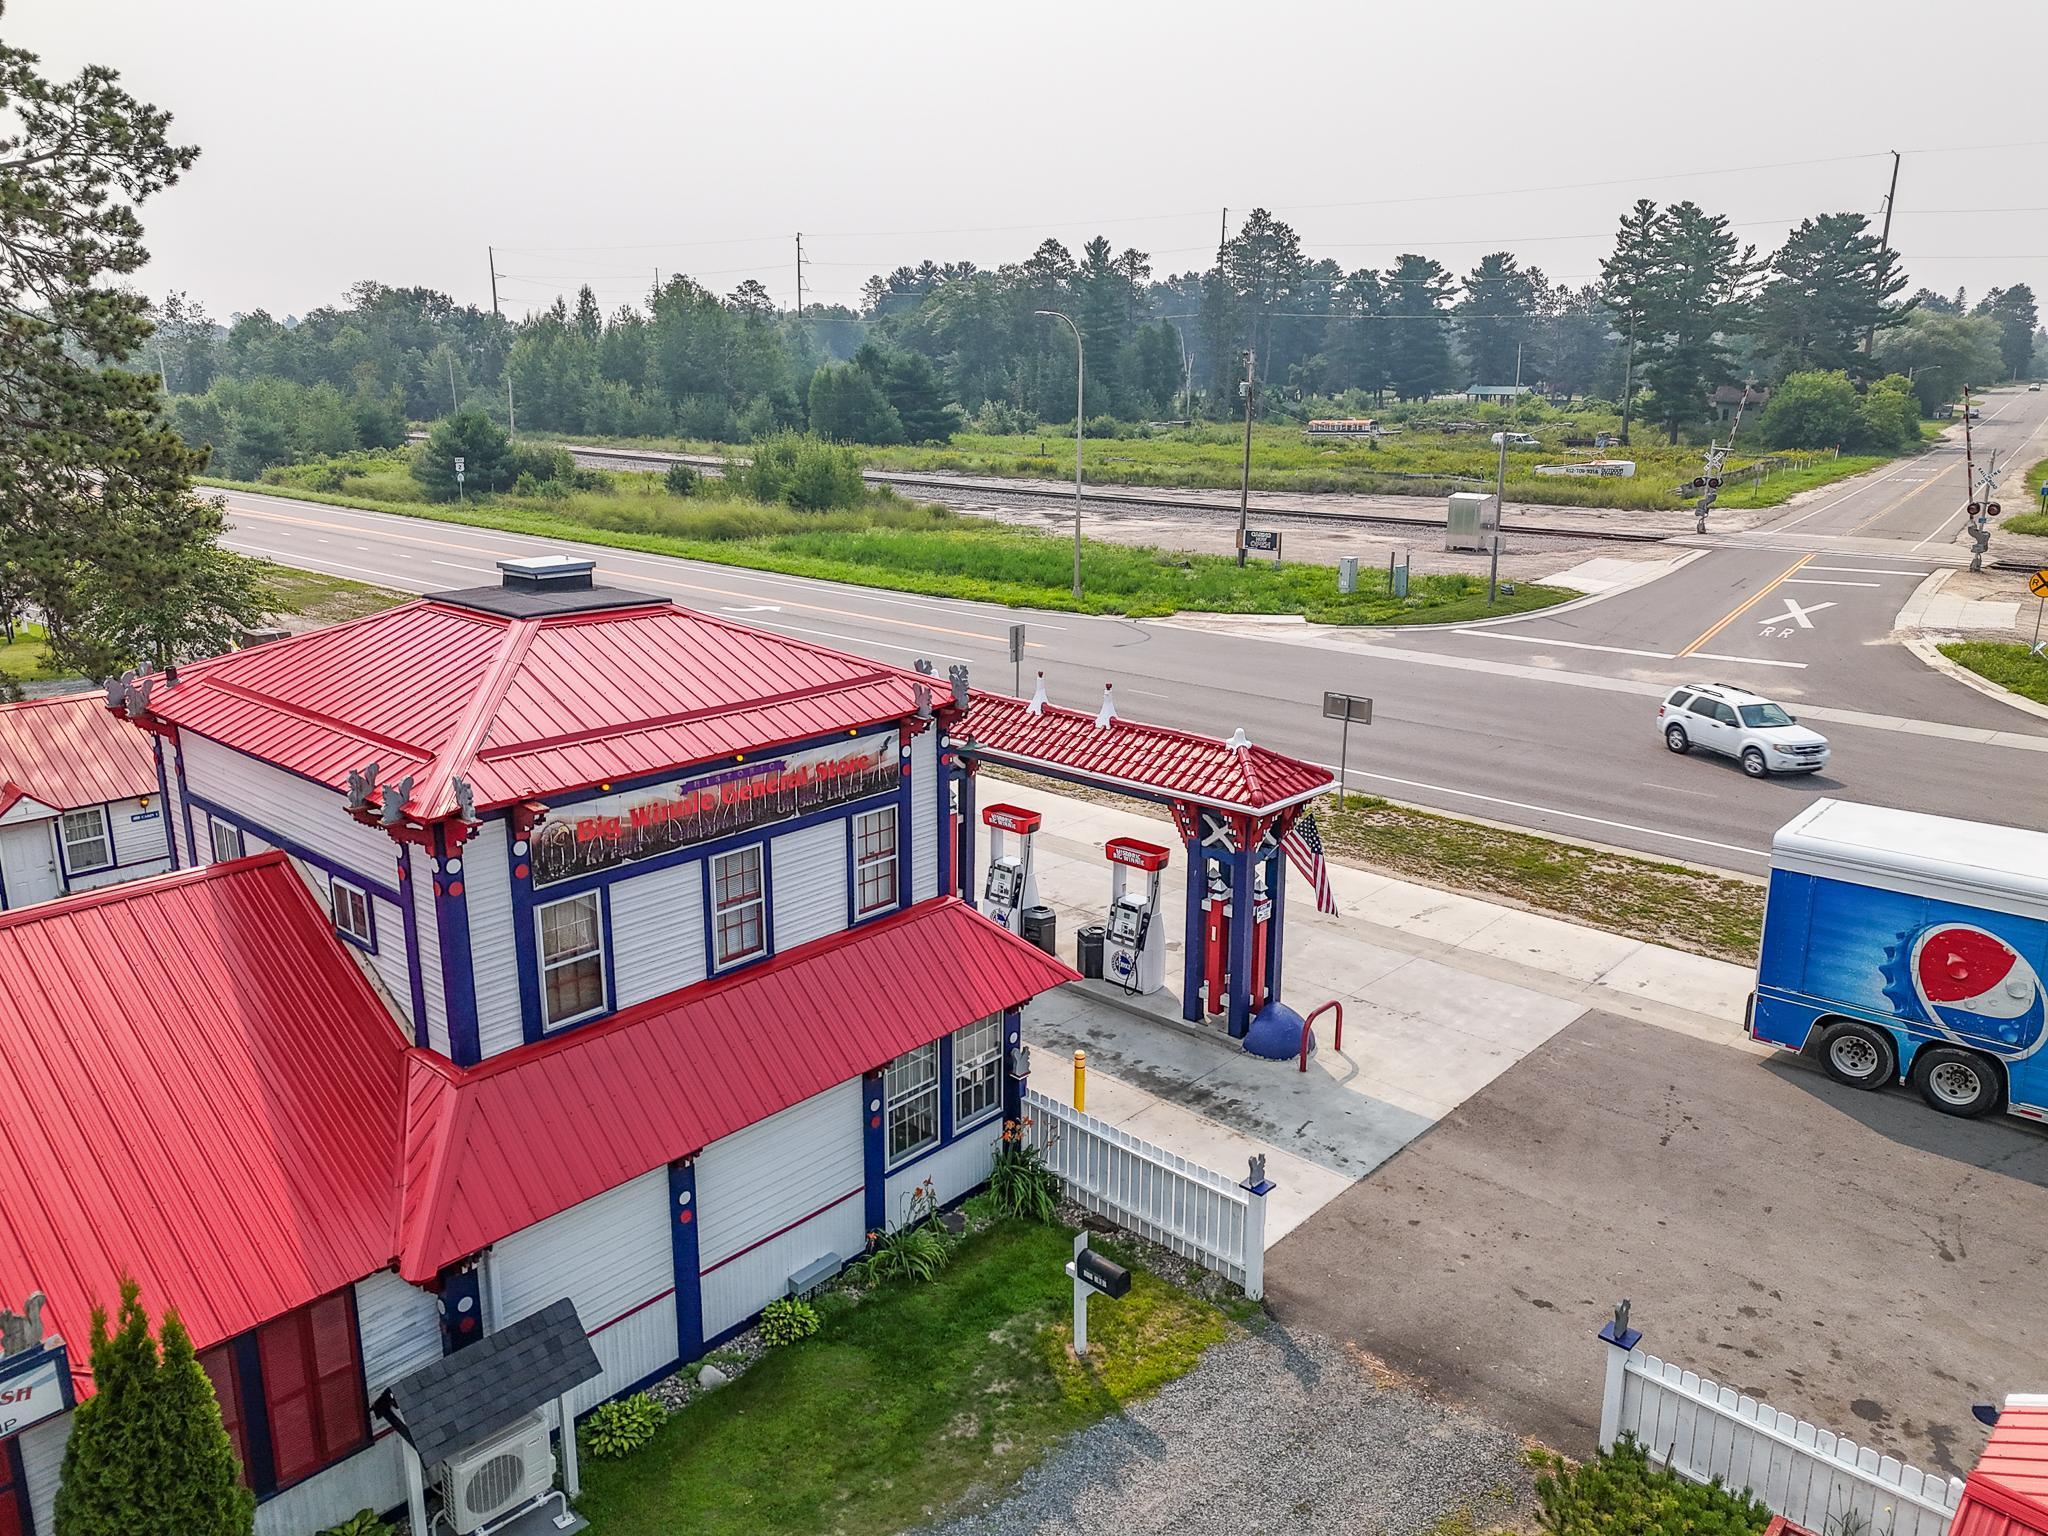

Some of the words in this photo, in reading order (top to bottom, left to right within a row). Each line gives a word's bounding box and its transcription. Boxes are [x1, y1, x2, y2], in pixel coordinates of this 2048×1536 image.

[2031, 578, 2040, 586] R
[693, 762, 776, 788] HISTORIC
[576, 815, 622, 843] Big
[629, 792, 714, 829] Winnie
[721, 765, 808, 805] General
[815, 754, 869, 783] Store
[827, 783, 864, 801] Liquor
